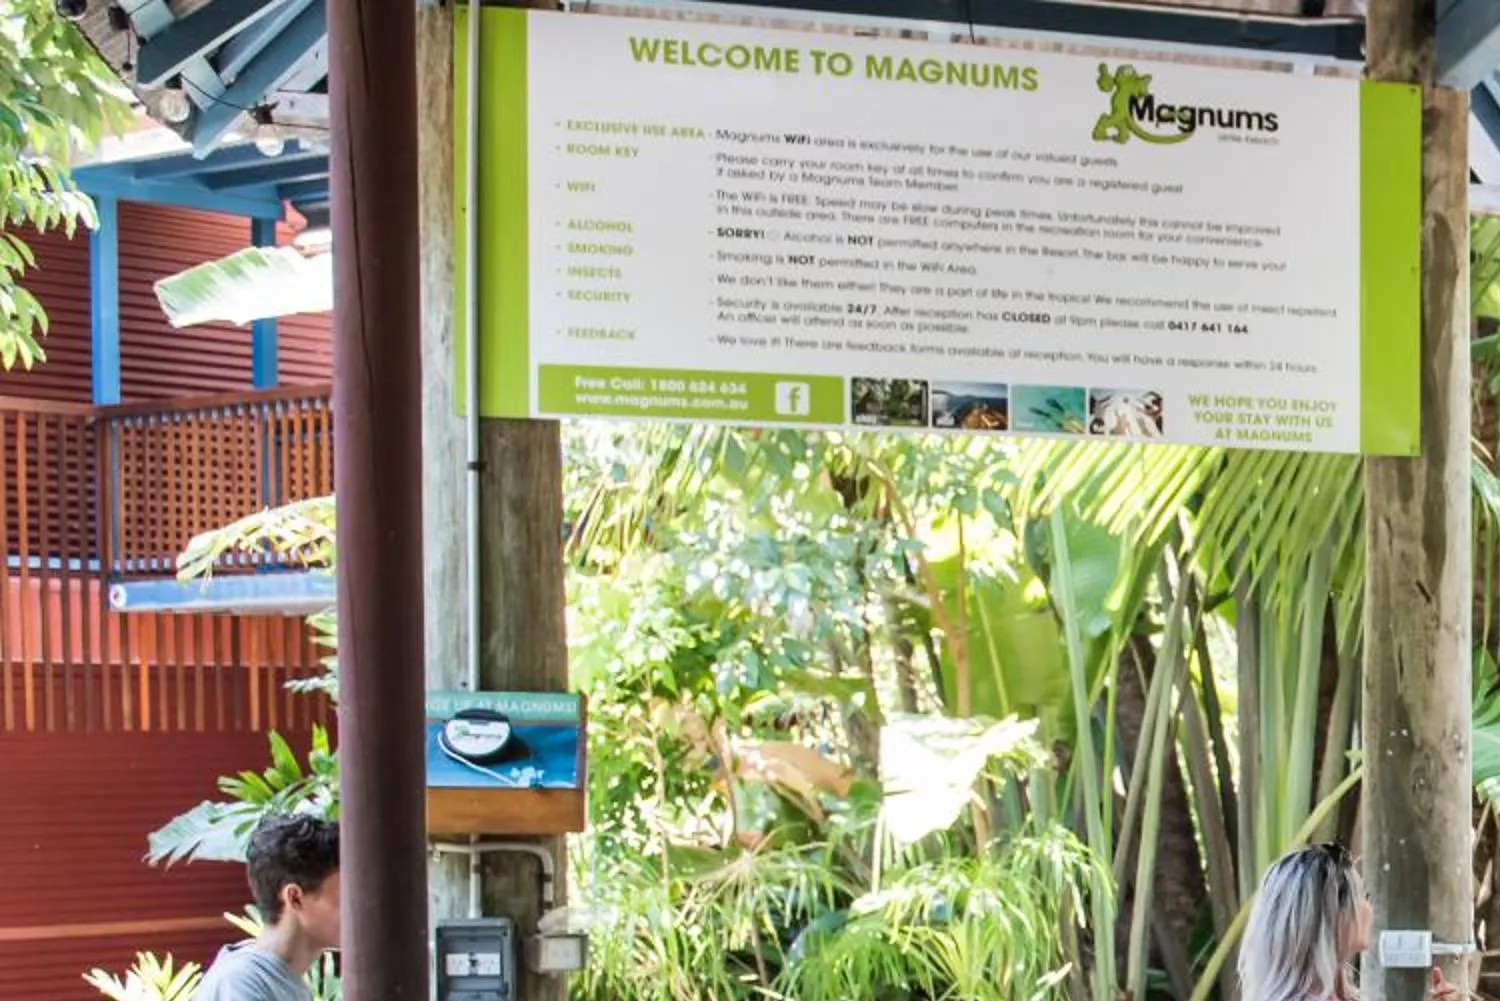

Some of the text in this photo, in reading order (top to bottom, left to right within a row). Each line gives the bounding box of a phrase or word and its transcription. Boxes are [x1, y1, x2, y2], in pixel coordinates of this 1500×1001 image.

[629, 37, 1039, 92] WELCOME TO MAGNUMS
[1128, 93, 1279, 134] Magnums
[567, 120, 704, 138] EXCLUSIVE USE AREA
[784, 133, 811, 145] WiFi
[567, 143, 638, 157] ROOM KEY
[567, 218, 633, 233] ALCOHOL
[717, 226, 765, 239] SORRY!
[784, 230, 832, 243] Alcohol
[848, 234, 874, 245] NOT
[567, 242, 634, 257] SMOKING
[717, 249, 772, 265] Smoking
[788, 253, 814, 265] NOT
[819, 257, 879, 269] permitted
[567, 265, 622, 280] INSECTS
[567, 289, 631, 304] SECURITY
[1002, 310, 1051, 322] CLOSED
[1168, 319, 1196, 330] 0417
[1202, 321, 1221, 332] 641
[567, 327, 634, 341] FEEDBACK
[575, 376, 607, 389] Free
[610, 376, 644, 391] Call:
[651, 378, 684, 392] 1800
[575, 393, 748, 410] www.magnums.com.au
[1188, 394, 1337, 412] WE HOPE YOU ENJOY
[1193, 410, 1334, 428] YOUR STAY WITH US
[1215, 427, 1313, 442] AT MAGNUMS
